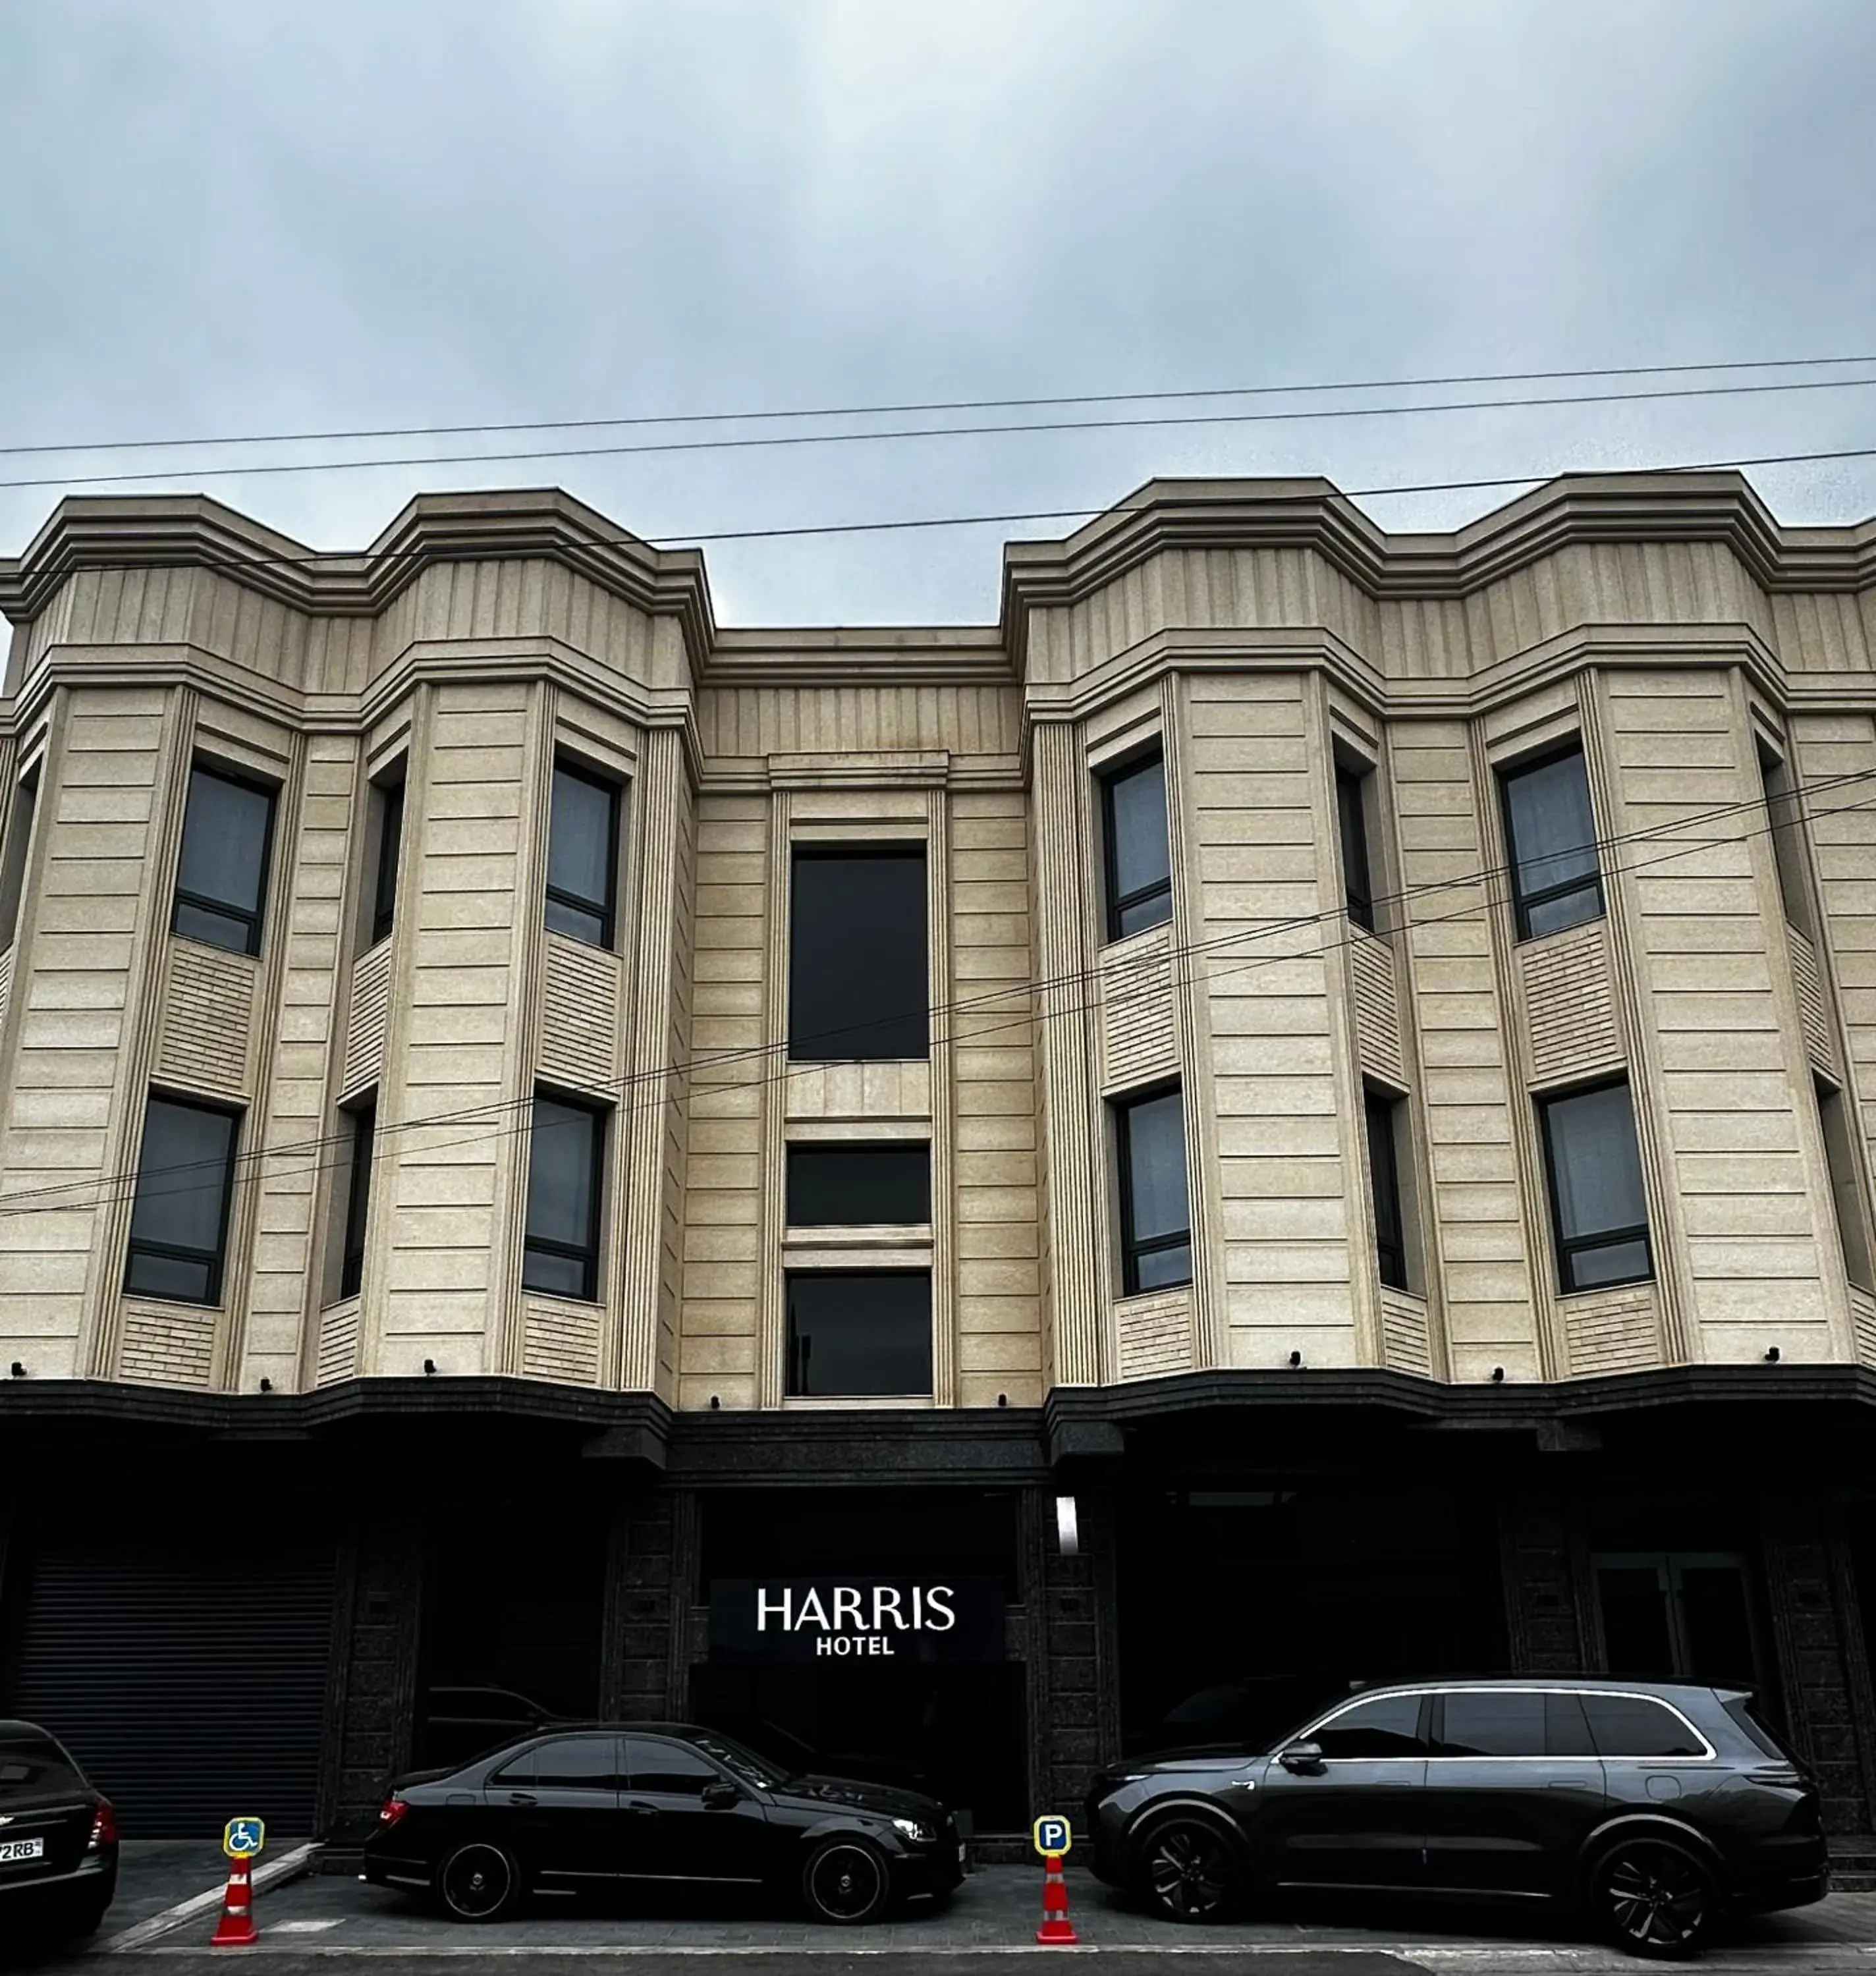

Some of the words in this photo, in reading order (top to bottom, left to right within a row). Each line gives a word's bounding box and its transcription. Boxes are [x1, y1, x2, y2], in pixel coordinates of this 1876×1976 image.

[757, 1586, 955, 1631] HARRIS
[816, 1637, 895, 1655] HOTEL
[1045, 1824, 1062, 1846] P
